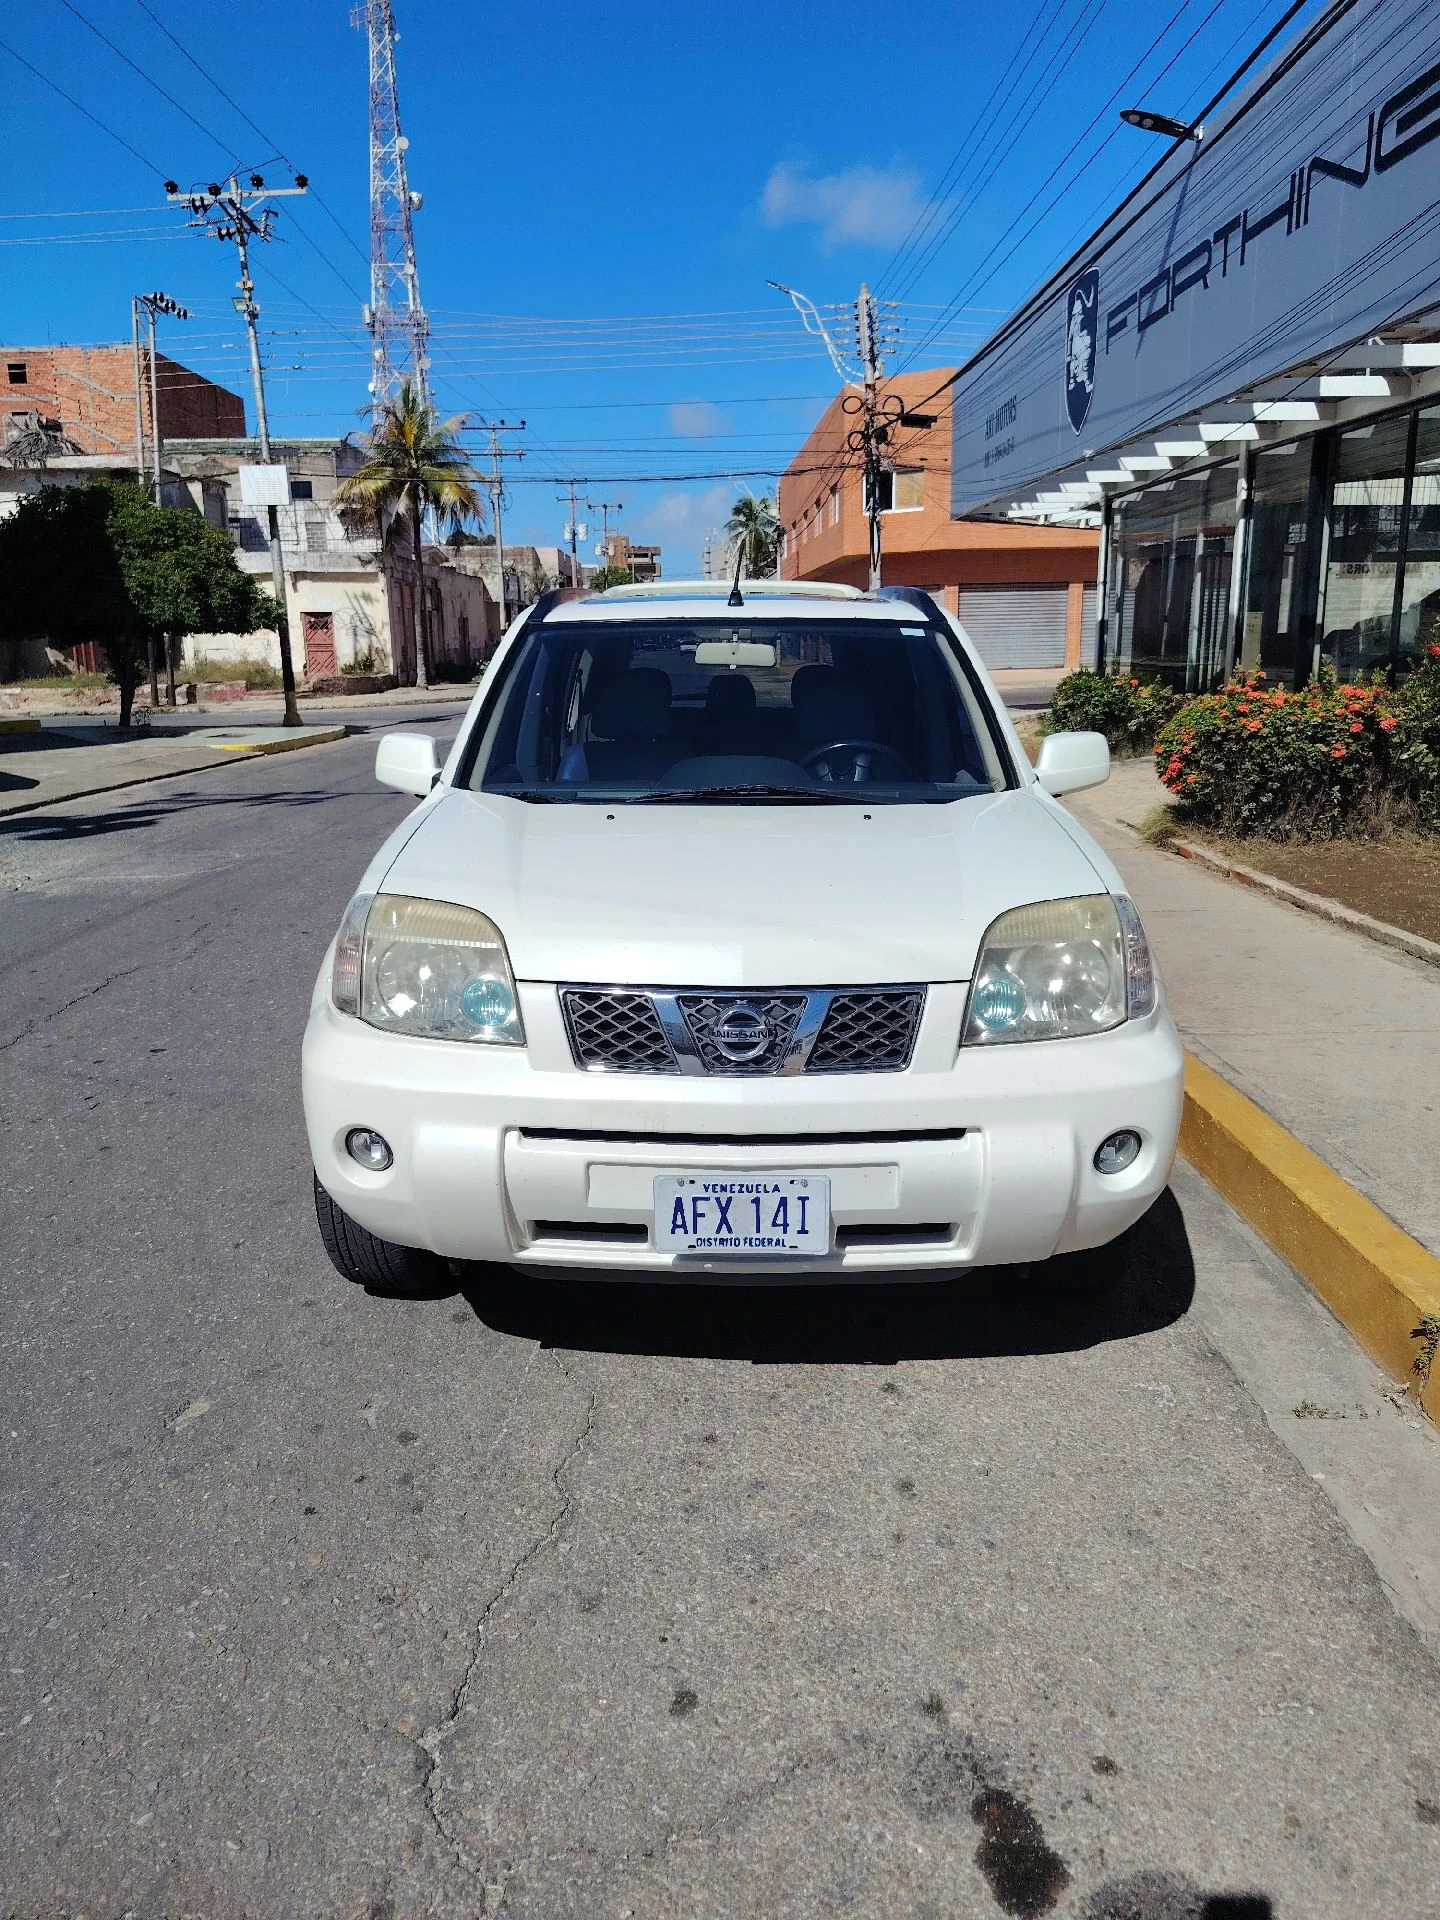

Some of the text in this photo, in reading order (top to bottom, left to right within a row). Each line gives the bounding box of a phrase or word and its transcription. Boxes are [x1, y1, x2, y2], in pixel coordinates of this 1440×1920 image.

[715, 1030, 768, 1039] NISSAN
[703, 1184, 781, 1193] VENEZUELA
[670, 1196, 809, 1234] AFX 14I
[696, 1237, 786, 1247] DISTRITO FEDERAL
